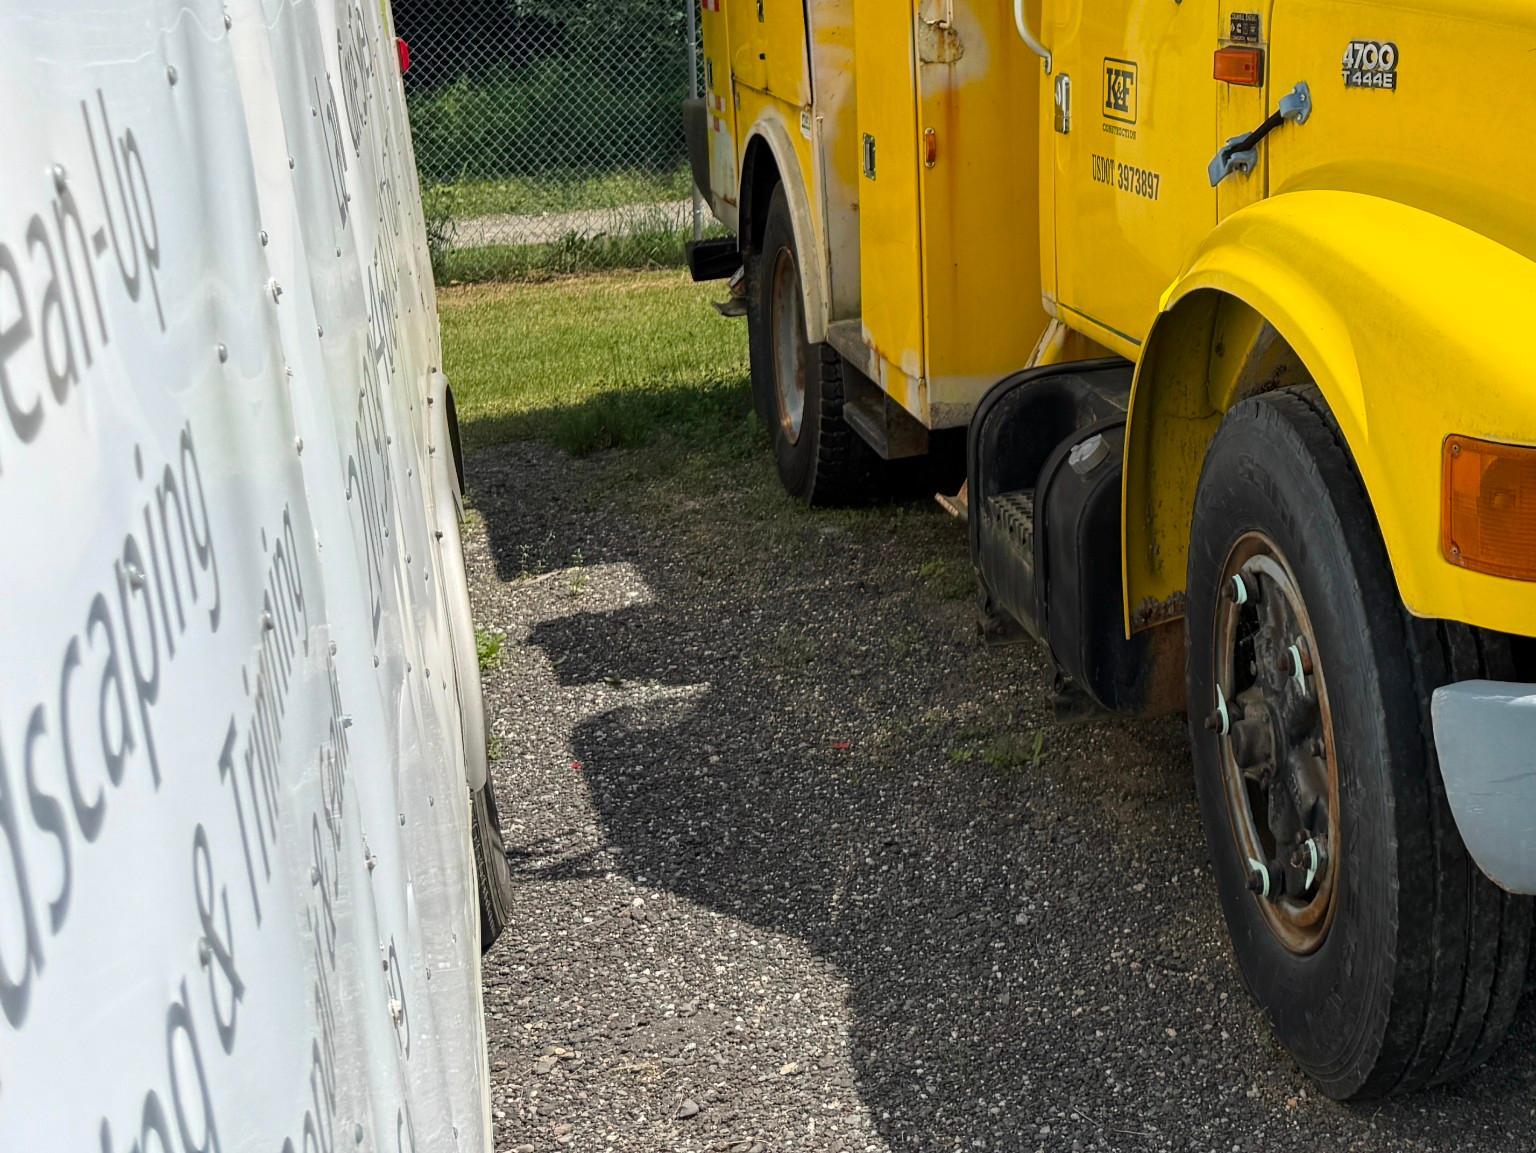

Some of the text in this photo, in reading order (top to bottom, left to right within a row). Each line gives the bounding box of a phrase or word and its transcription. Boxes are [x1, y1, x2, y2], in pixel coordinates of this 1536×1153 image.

[1342, 42, 1396, 70] 4700
[1105, 67, 1134, 112] K&F
[1342, 70, 1393, 88] T 444E
[1102, 123, 1137, 140] CONSTRUCTION
[1091, 153, 1160, 200] USDOT 3973897
[0, 88, 166, 445] ean-Up
[193, 821, 246, 1056] &
